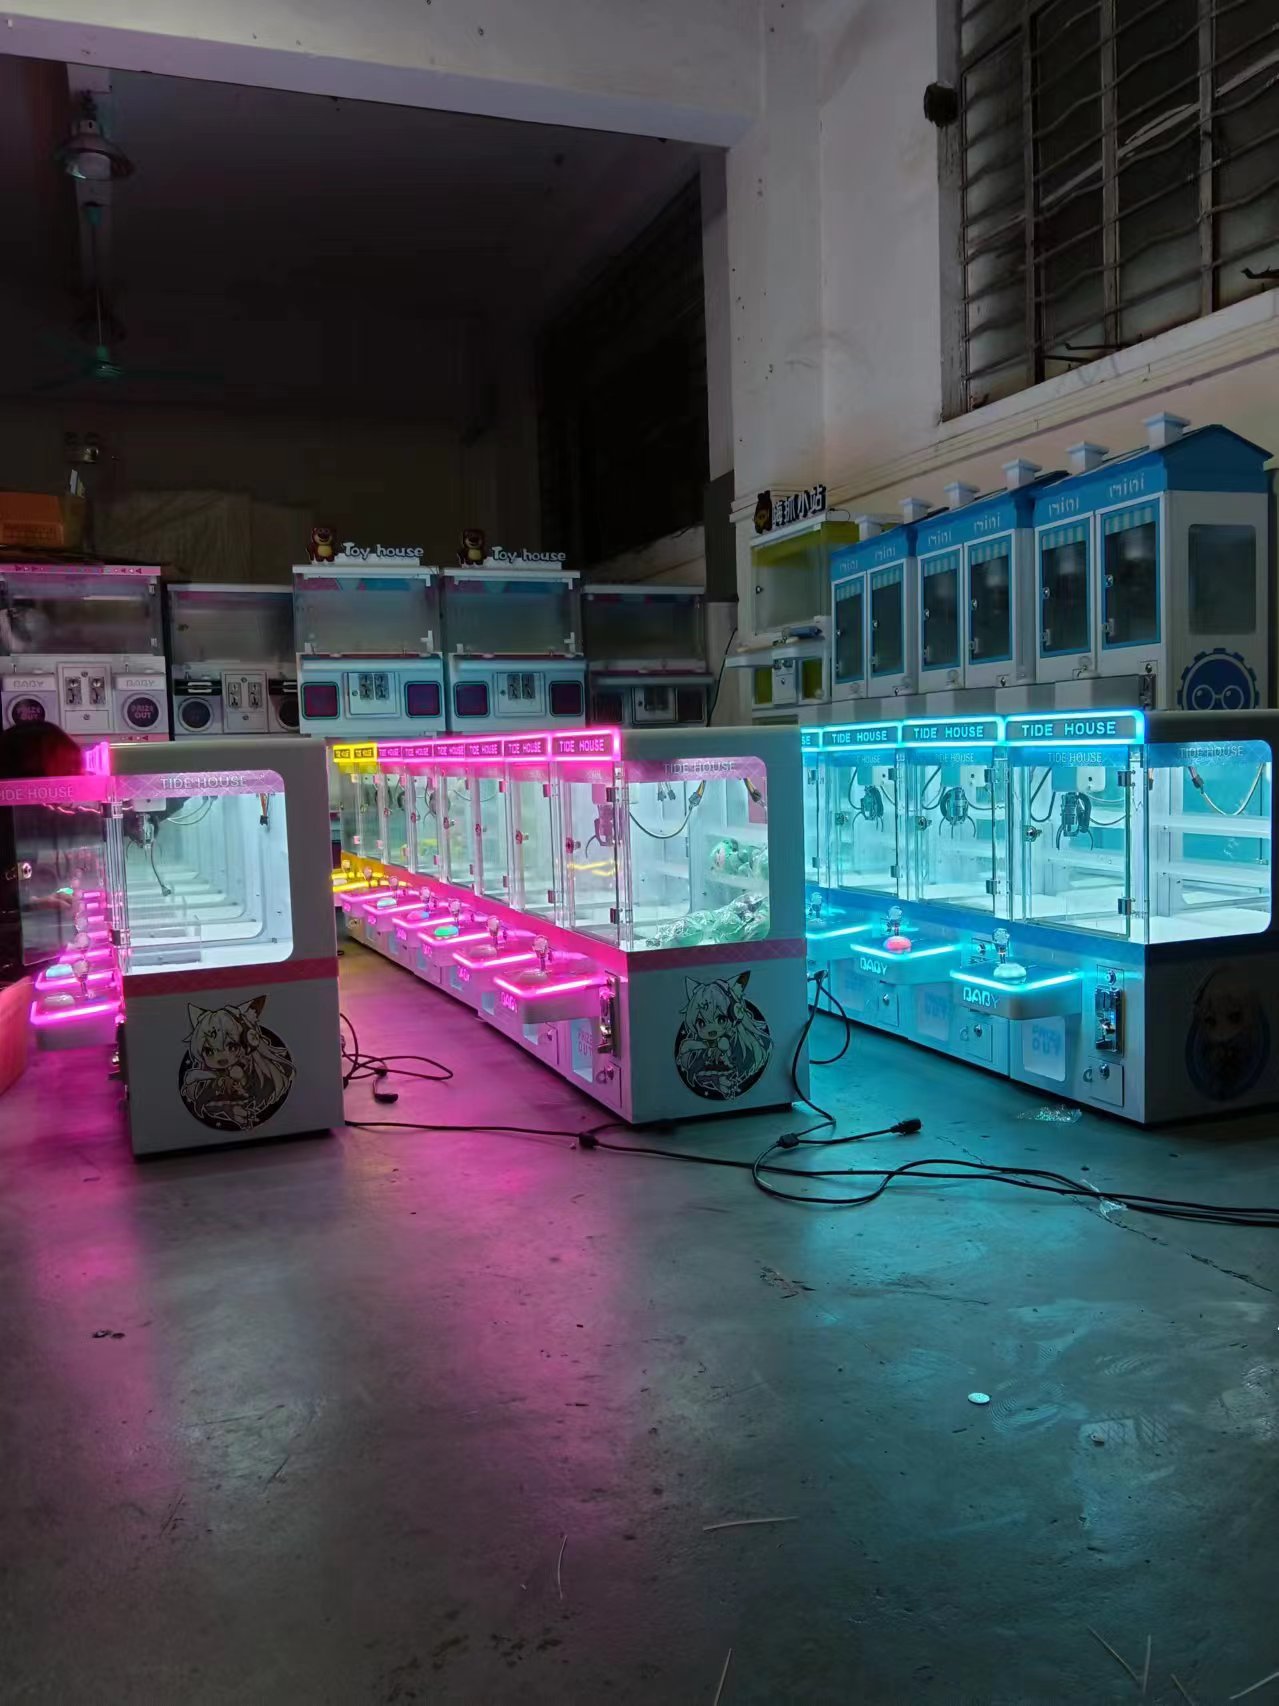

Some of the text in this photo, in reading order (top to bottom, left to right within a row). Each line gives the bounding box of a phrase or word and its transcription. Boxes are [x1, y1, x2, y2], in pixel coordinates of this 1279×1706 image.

[342, 542, 424, 561] Toy house
[492, 546, 567, 563] Toy house
[913, 726, 984, 739] TIDE HOUSE
[1021, 721, 1117, 737] TIDE HOUSE
[832, 731, 888, 743] TIDE HOUSE
[559, 739, 605, 753] TIDE HOUSE
[1206, 745, 1244, 758] HOUSE
[1047, 752, 1102, 763] TIDE HOUSE
[664, 761, 737, 775] TIDE HOUSE
[160, 776, 247, 790] TIDE HOUSE
[28, 786, 73, 799] HOUSE
[963, 987, 999, 1009] BABY
